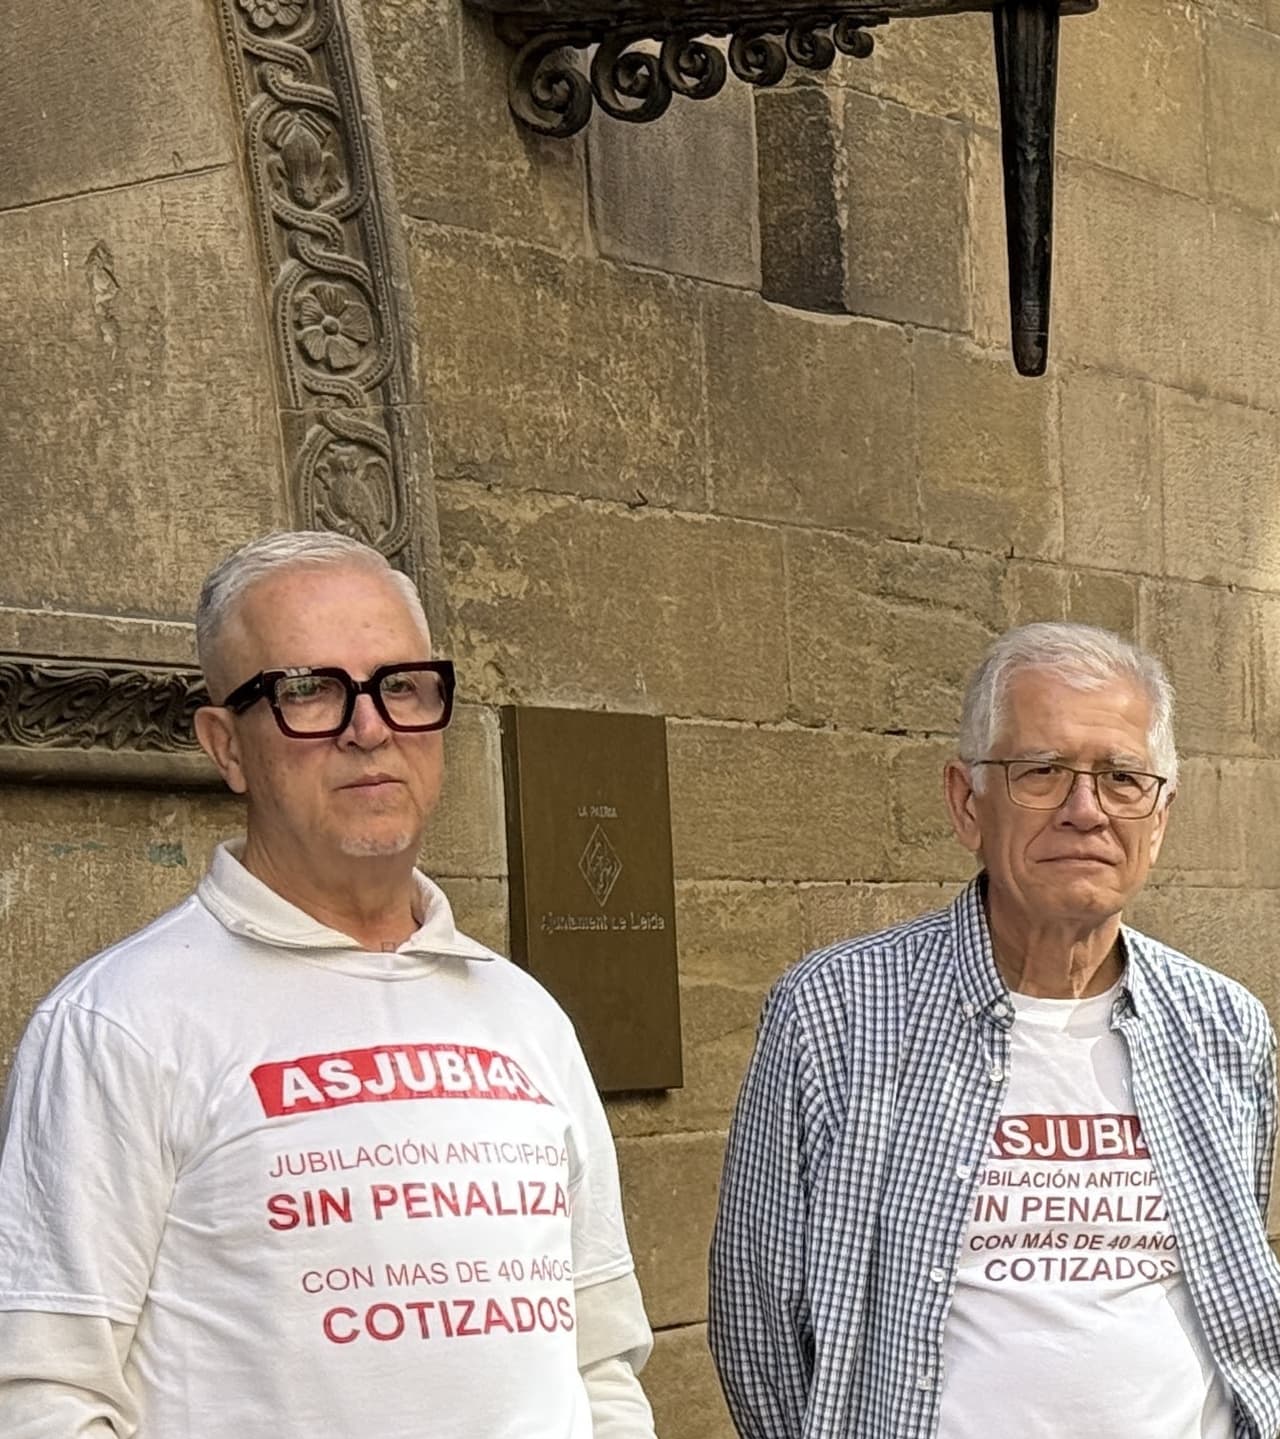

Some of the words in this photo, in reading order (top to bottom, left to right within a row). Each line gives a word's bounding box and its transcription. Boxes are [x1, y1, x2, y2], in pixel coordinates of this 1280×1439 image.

[282, 1050, 541, 1107] ASJUBI40
[269, 1139, 438, 1178] JUBILACIÓN
[267, 1187, 352, 1231] SIN
[371, 1181, 570, 1220] PENALIZA
[974, 1195, 1008, 1222] IN
[969, 1234, 1016, 1251] CON
[1022, 1229, 1068, 1250] MÁS
[1073, 1234, 1107, 1250] DE
[1107, 1234, 1129, 1250] 40
[1135, 1231, 1178, 1250] AÑO
[302, 1264, 374, 1293] CON
[385, 1262, 449, 1287] MAS
[456, 1261, 491, 1283] DE
[498, 1259, 524, 1281] 40
[530, 1255, 573, 1282] AÑOS
[984, 1257, 1175, 1281] COTIZADOS
[323, 1296, 574, 1344] COTIZADOS
